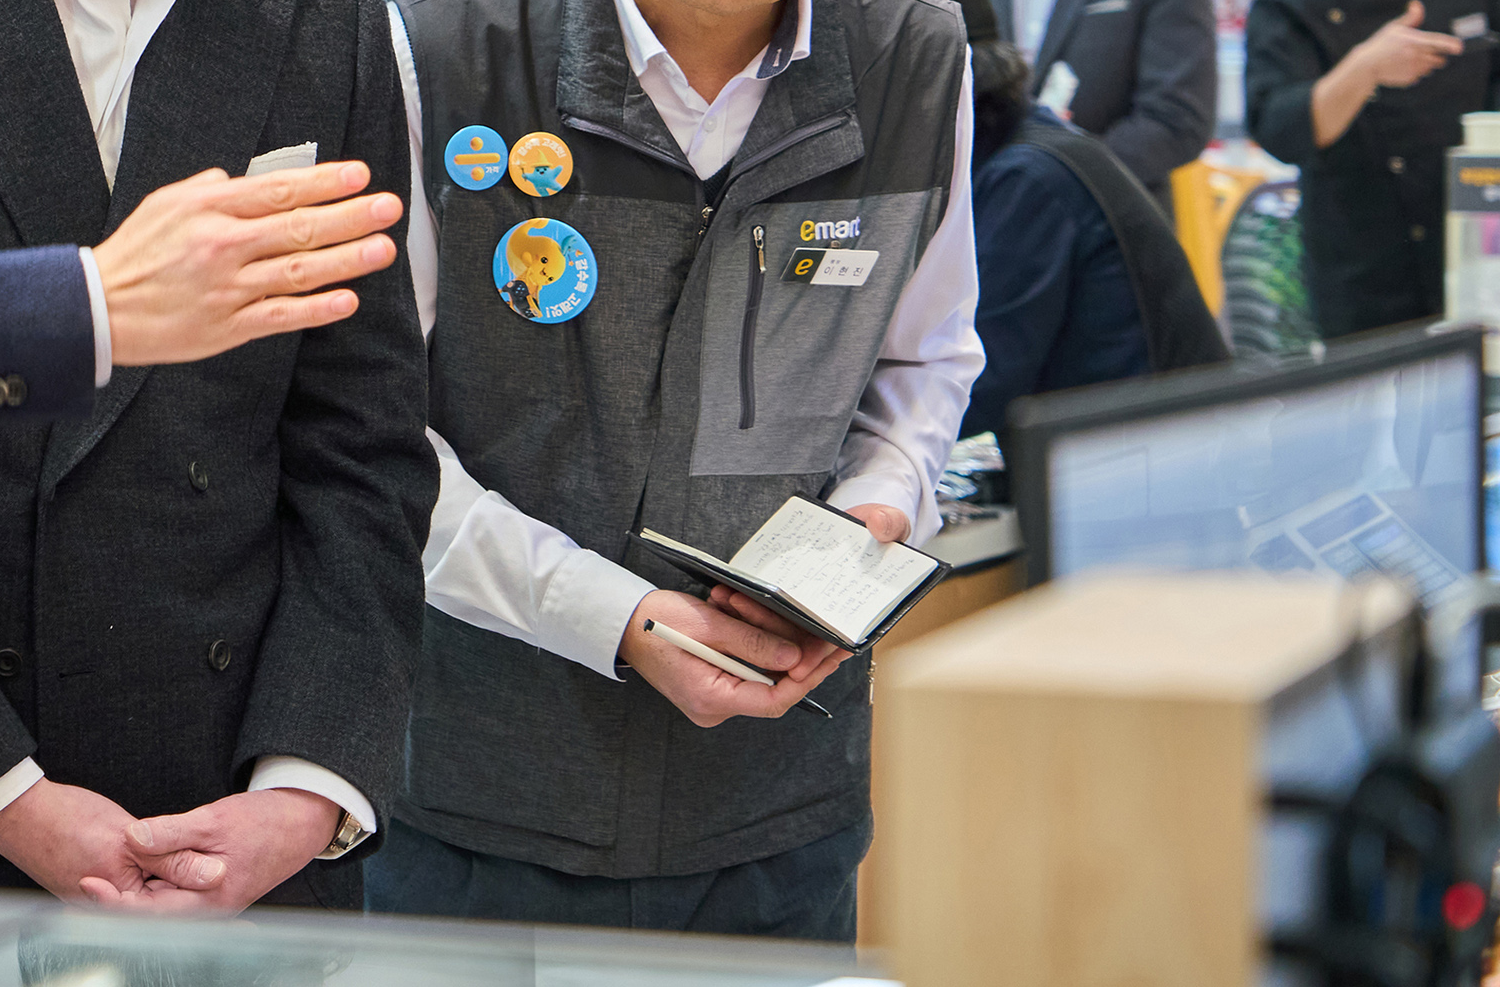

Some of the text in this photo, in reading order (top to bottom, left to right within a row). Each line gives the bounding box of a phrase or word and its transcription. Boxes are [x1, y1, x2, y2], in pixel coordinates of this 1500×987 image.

[485, 165, 500, 174] 가격
[800, 216, 861, 241] emart
[794, 258, 814, 276] e
[545, 292, 582, 319] 고래잇!
